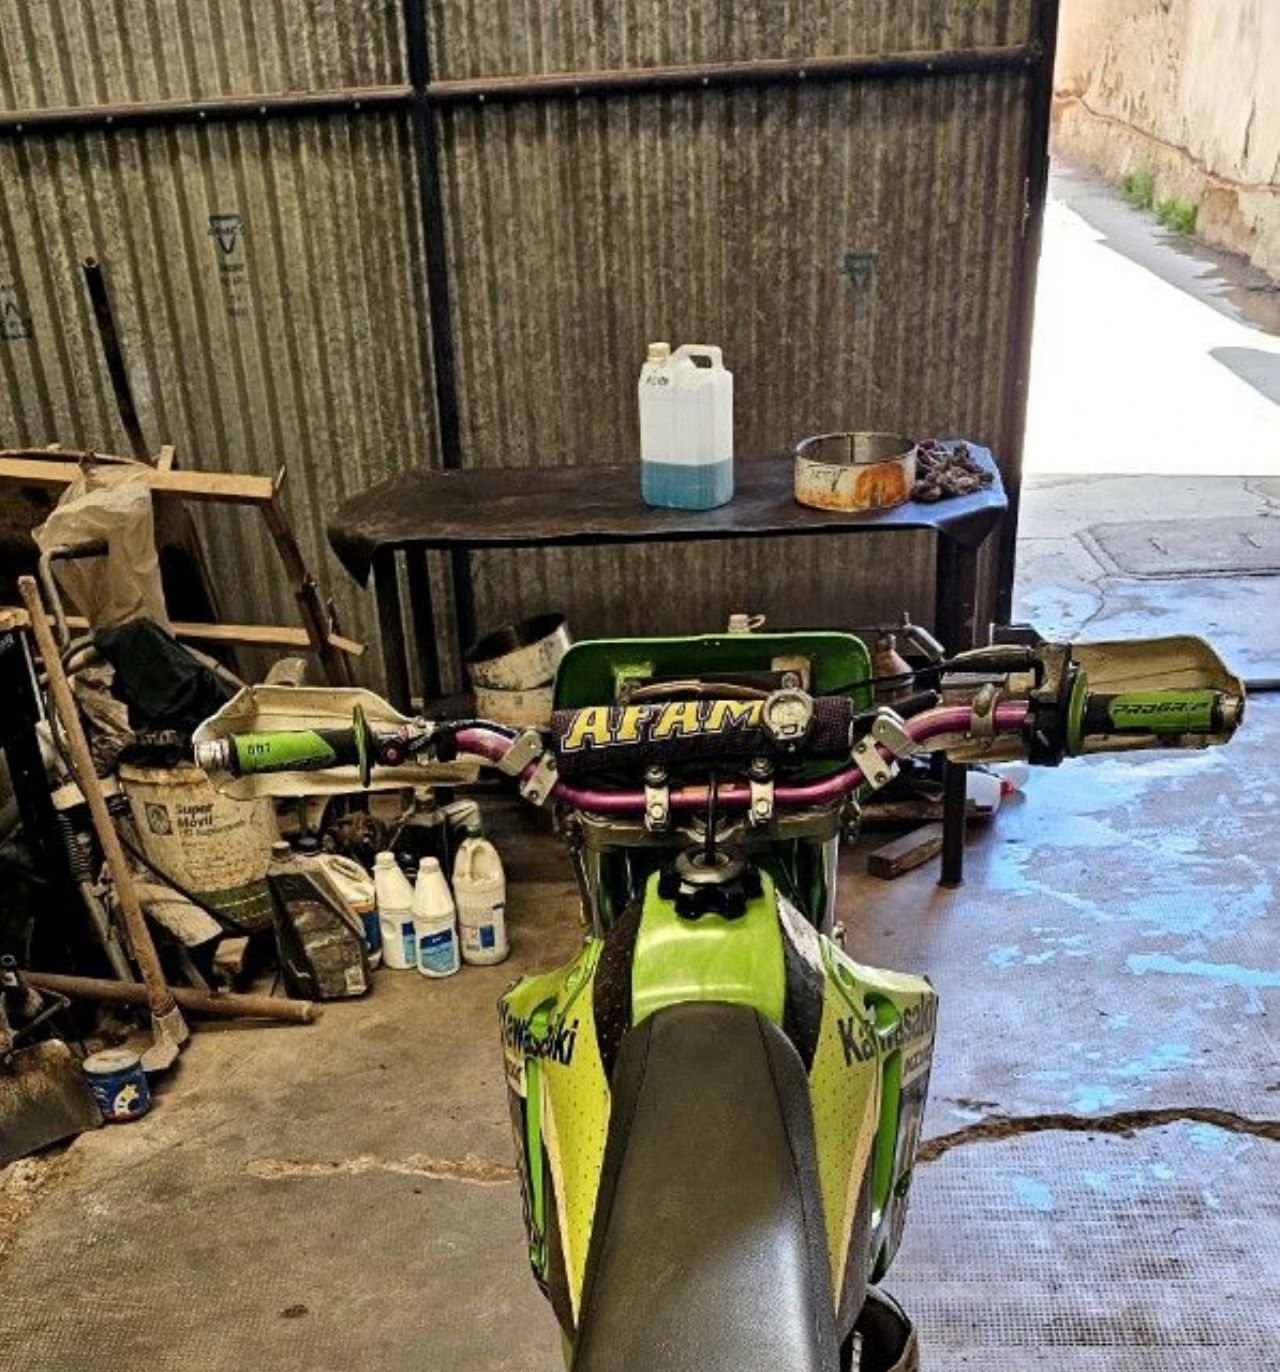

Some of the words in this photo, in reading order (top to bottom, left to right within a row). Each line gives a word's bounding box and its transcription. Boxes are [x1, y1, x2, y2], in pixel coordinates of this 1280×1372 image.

[1113, 702, 1209, 714] PROGRIP
[561, 699, 765, 751] AFAM
[175, 803, 214, 818] Super
